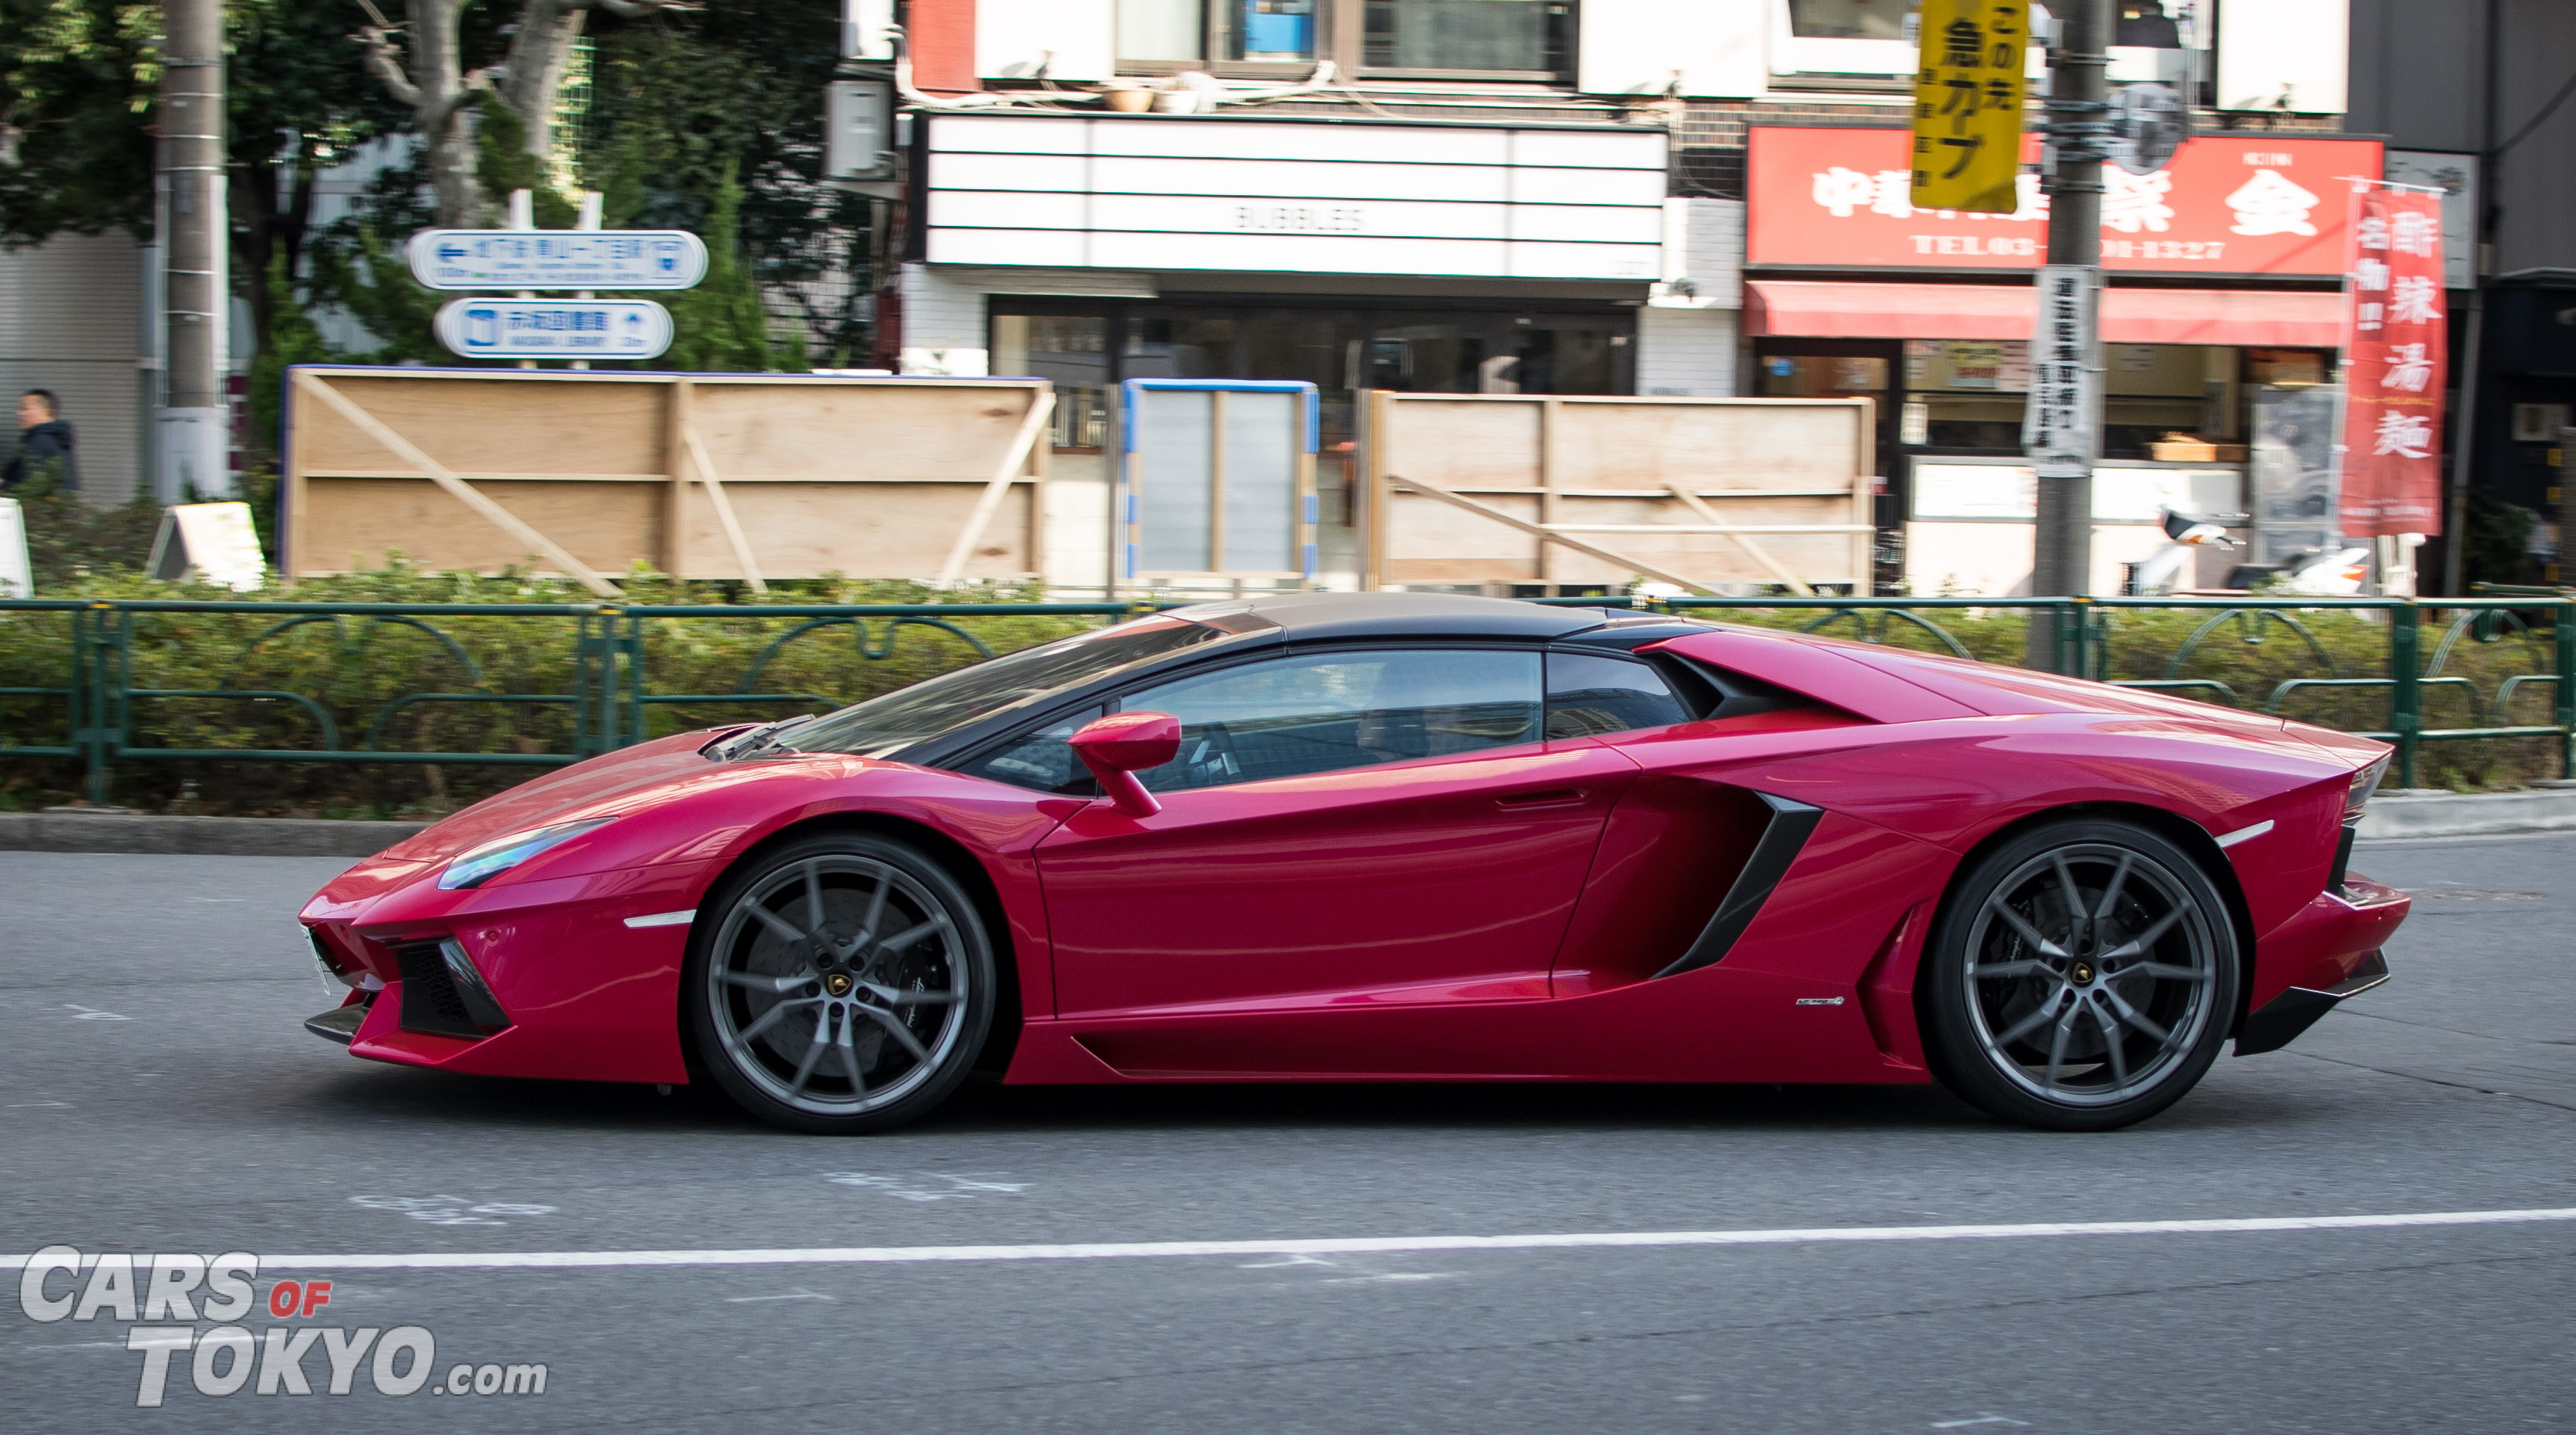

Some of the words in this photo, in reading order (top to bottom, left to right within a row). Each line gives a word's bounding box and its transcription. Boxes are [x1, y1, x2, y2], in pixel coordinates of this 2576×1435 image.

[1940, 18, 1986, 179] 急カーブ
[1989, 6, 2021, 110] この先
[1234, 208, 1363, 230] BUBBLES
